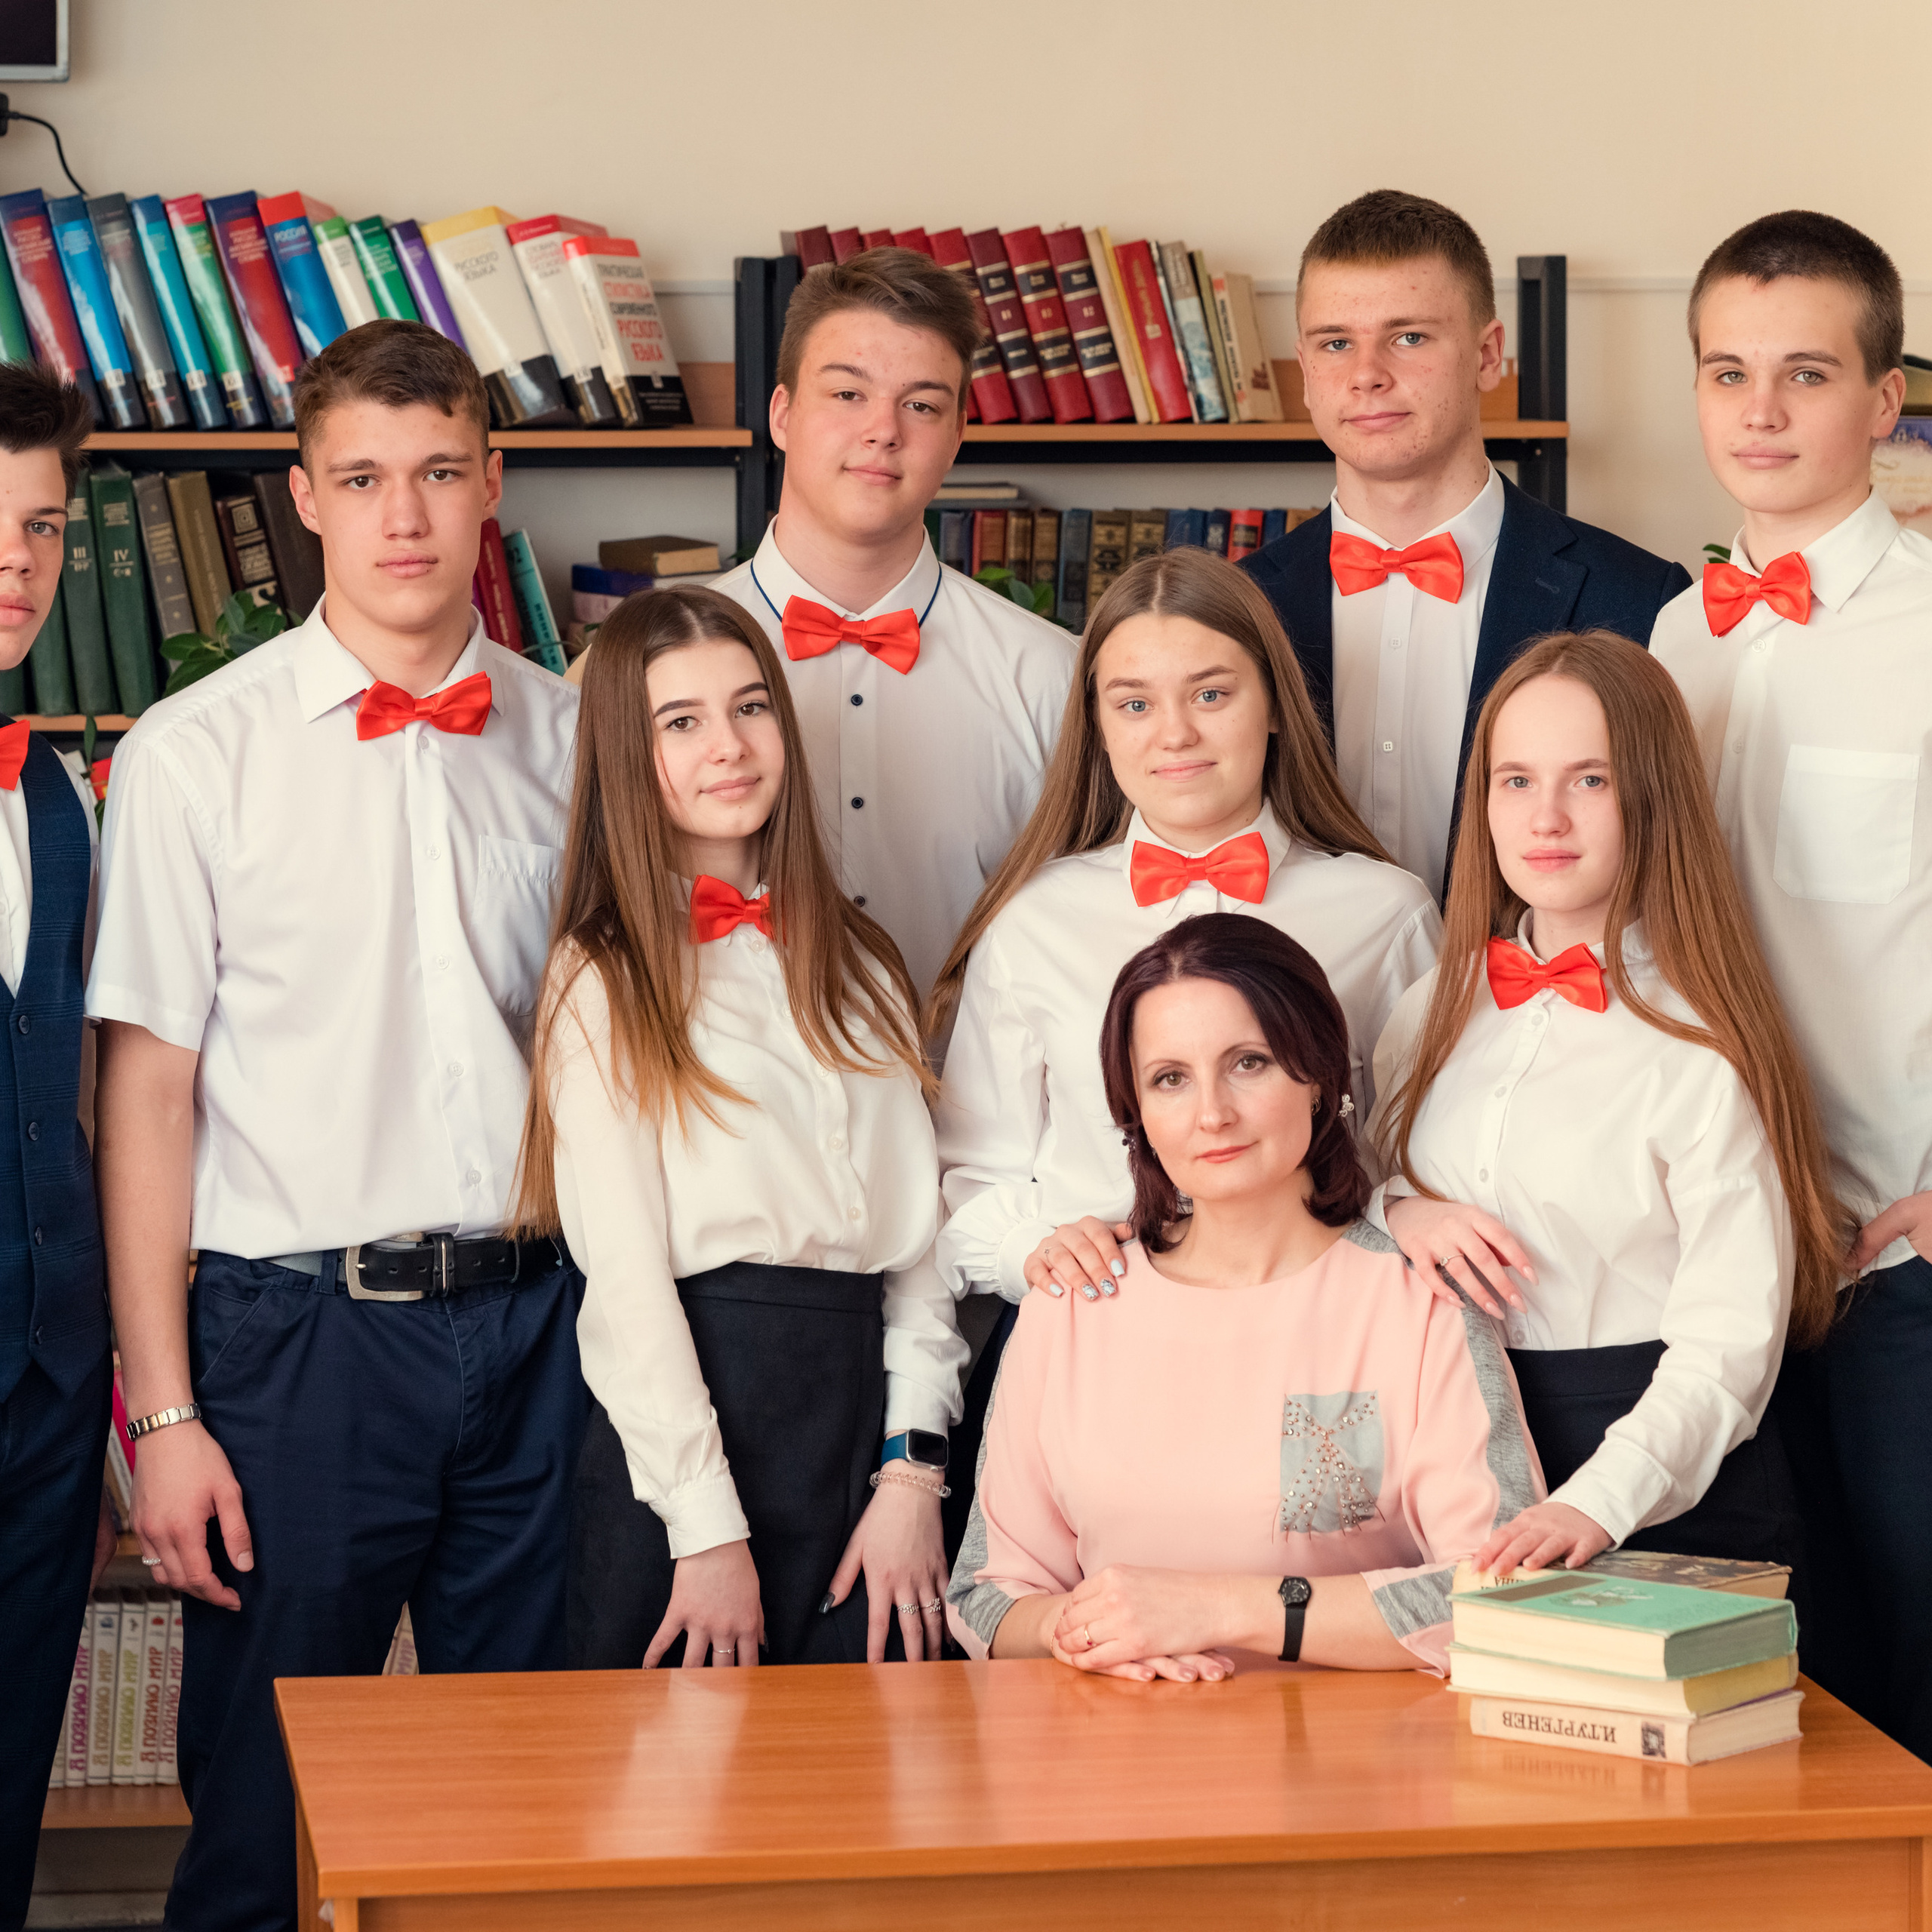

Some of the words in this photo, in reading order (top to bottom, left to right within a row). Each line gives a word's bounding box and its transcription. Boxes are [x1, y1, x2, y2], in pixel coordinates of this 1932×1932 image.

[73, 546, 87, 559] III
[114, 549, 129, 562] IV
[97, 1648, 112, 1683] МИР
[123, 1649, 139, 1684] МИР
[149, 1646, 162, 1679] МИР
[71, 1684, 88, 1754] ПОЗНАЮ
[94, 1686, 110, 1751] ПОЗНАЮ
[143, 1684, 160, 1748] ПОЗНАЮ
[162, 1684, 180, 1748] ПОЗНАЮ
[1502, 1711, 1617, 1743] И.ТУРГЕНЕВ
[69, 1758, 85, 1771] Я
[92, 1753, 109, 1766] Я
[115, 1755, 133, 1767] Я
[140, 1752, 156, 1763] Я
[158, 1752, 174, 1764] Я
